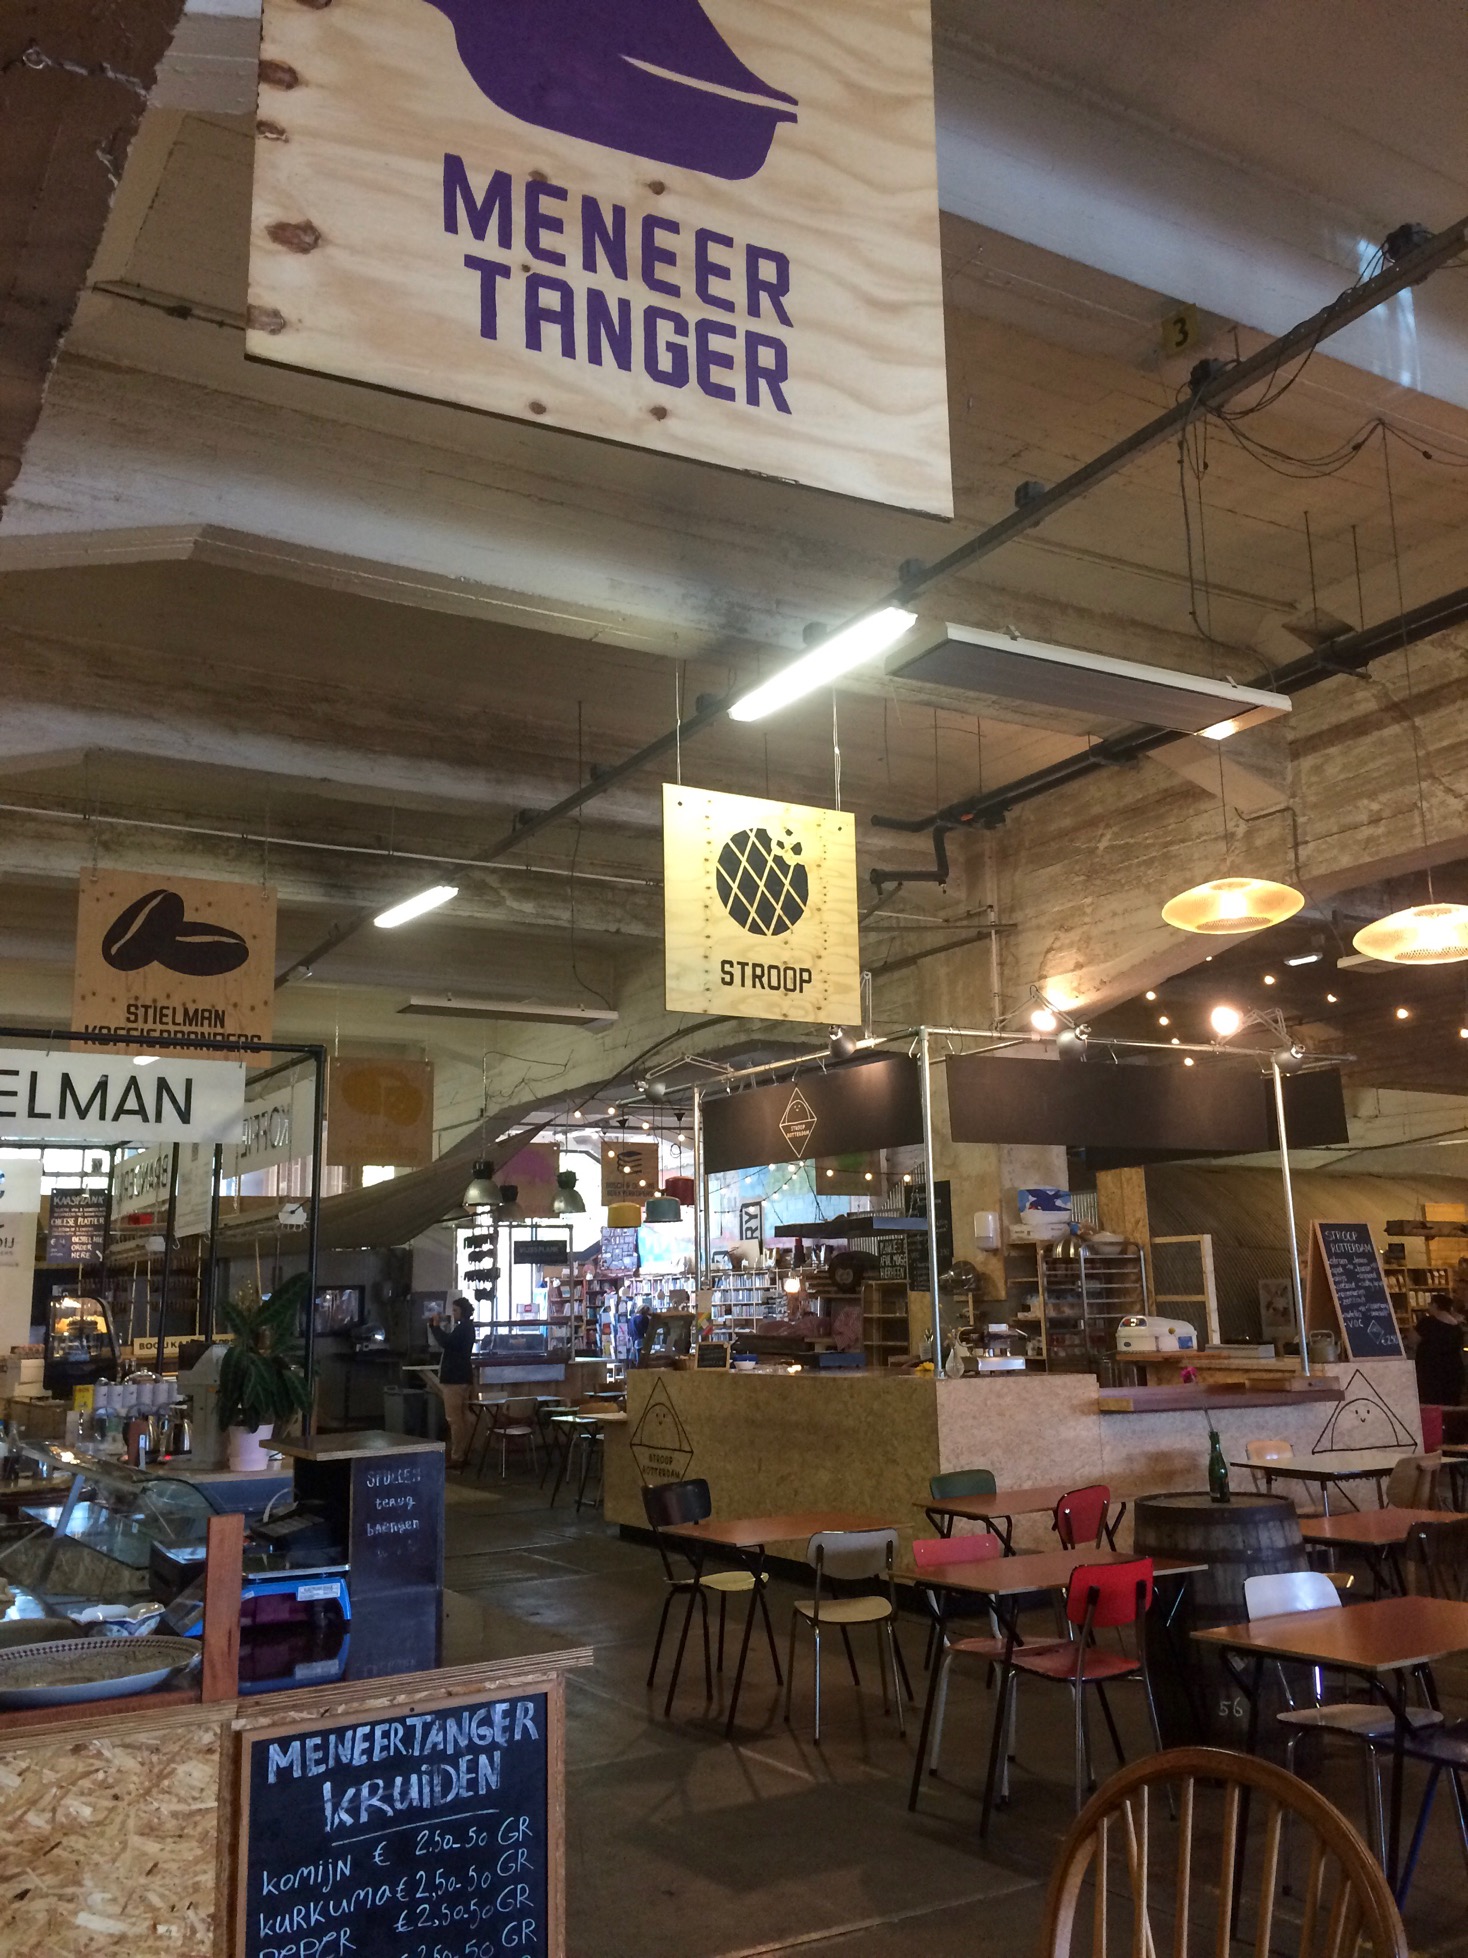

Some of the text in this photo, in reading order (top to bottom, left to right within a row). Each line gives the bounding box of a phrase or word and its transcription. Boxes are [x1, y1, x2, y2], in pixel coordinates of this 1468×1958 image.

[443, 152, 794, 328] MENEER
[463, 254, 792, 415] TANGER
[1172, 316, 1189, 348] 3
[720, 959, 813, 994] STROOP
[125, 1003, 226, 1029] STIELMAN
[1324, 1230, 1358, 1241] STROOP
[1330, 1242, 1372, 1254] ROTTERDAM
[139, 1341, 169, 1351] BOOJ
[648, 1453, 673, 1465] STROOP
[1218, 1696, 1244, 1718] 56
[497, 1815, 533, 1845] GR
[497, 1849, 535, 1877] GR
[496, 1883, 535, 1913] GR
[501, 1918, 538, 1948] GR
